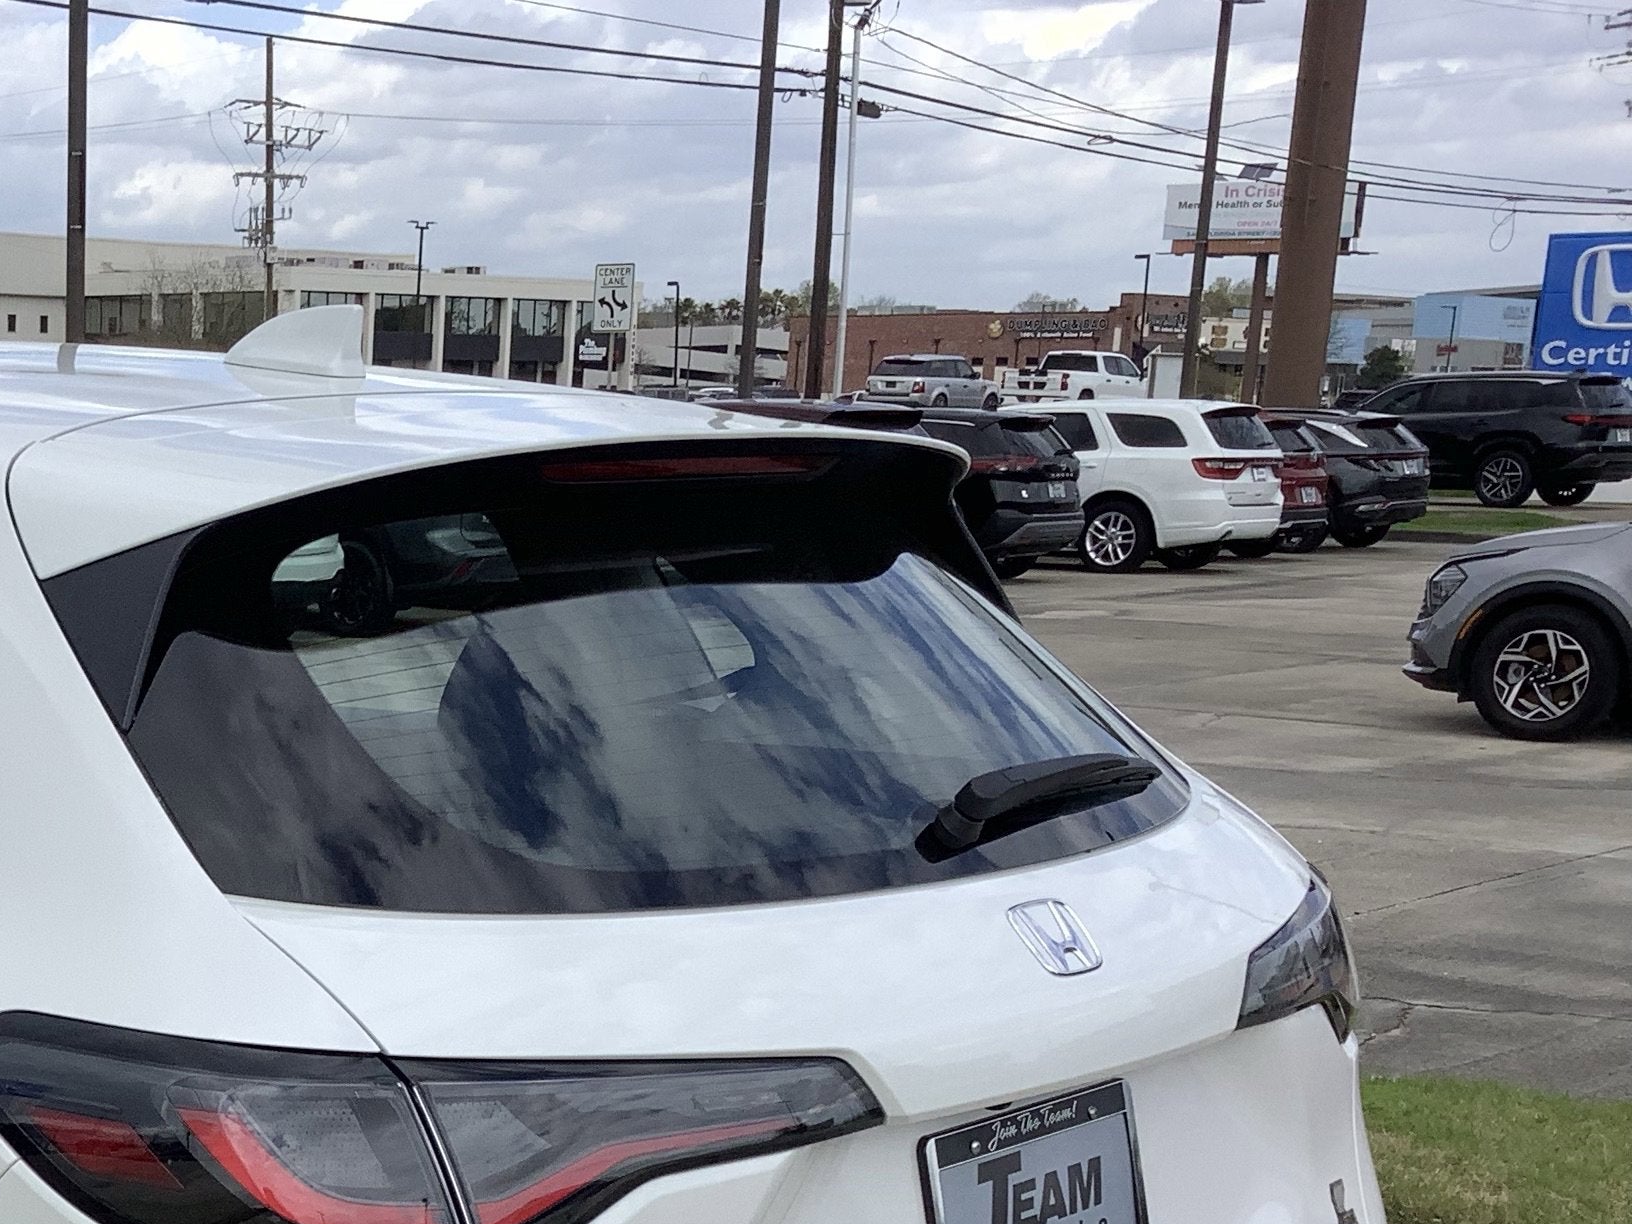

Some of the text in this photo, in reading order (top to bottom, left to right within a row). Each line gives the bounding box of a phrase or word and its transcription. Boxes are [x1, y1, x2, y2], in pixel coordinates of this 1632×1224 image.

[1224, 185, 1239, 198] In
[1216, 200, 1250, 209] Health
[1252, 200, 1263, 208] or
[598, 267, 631, 277] CENTER
[602, 277, 625, 286] LANE
[600, 319, 623, 329] ONLY
[1008, 317, 1108, 331] DUMPLING & BAO
[1540, 340, 1630, 366] Certi
[987, 1100, 1078, 1152] Join The Team!
